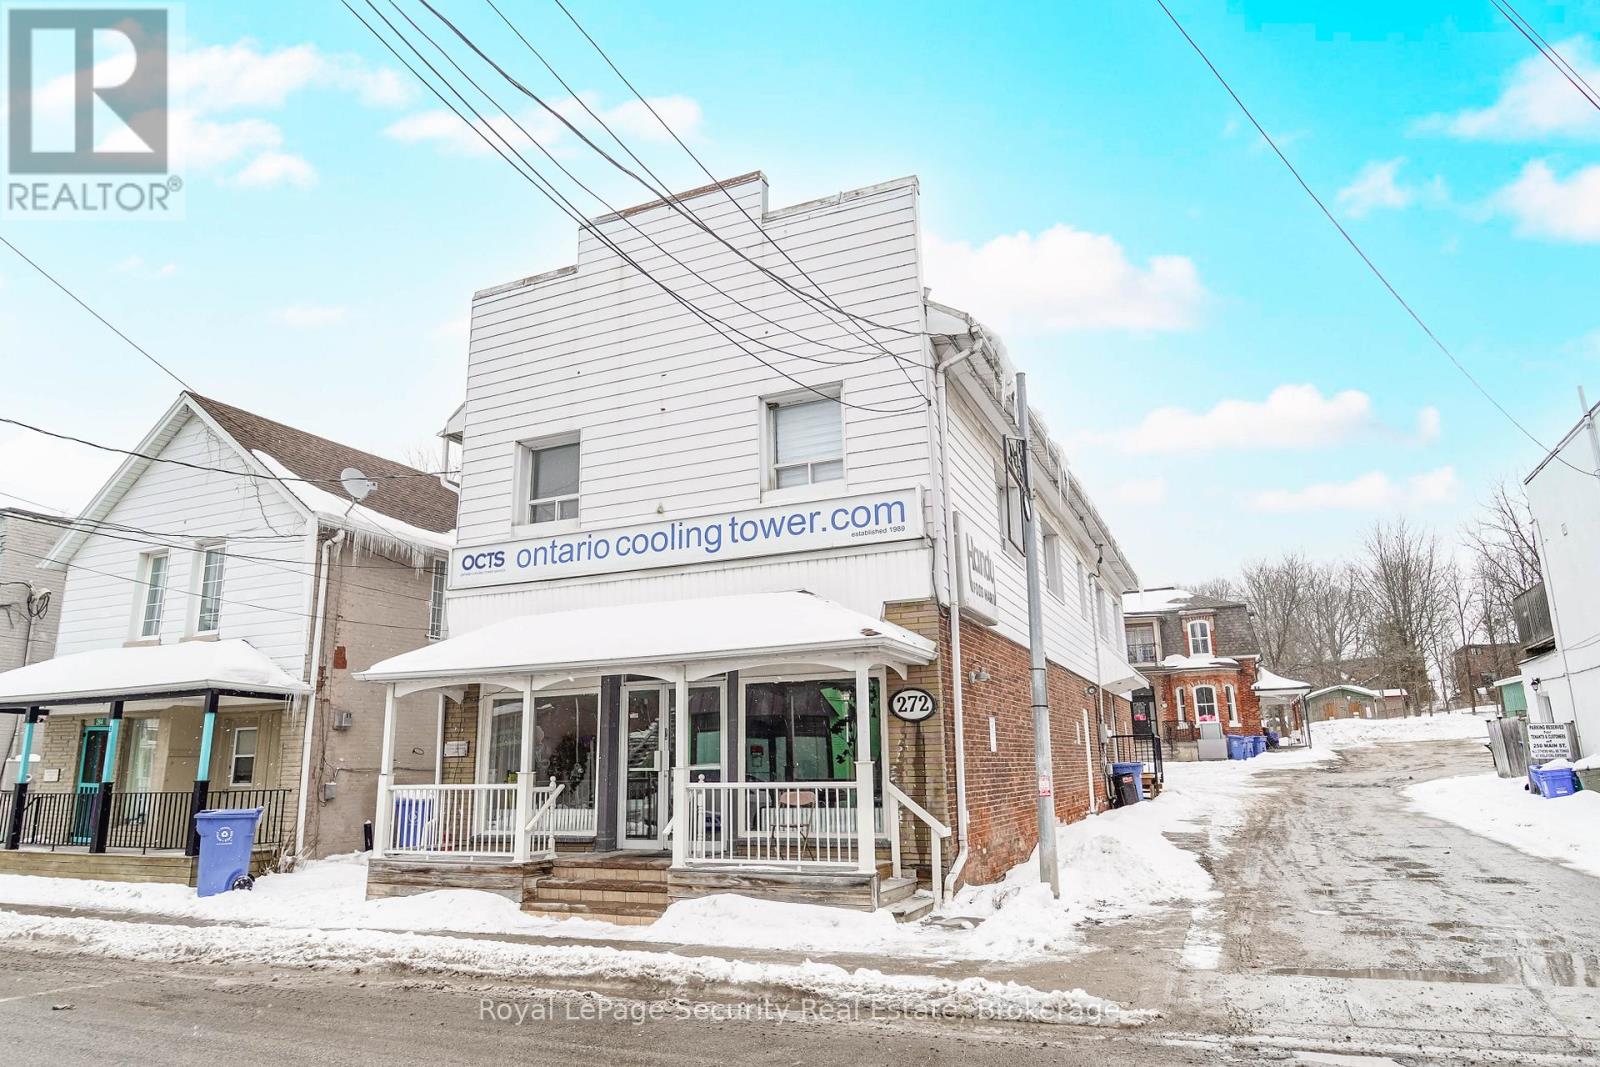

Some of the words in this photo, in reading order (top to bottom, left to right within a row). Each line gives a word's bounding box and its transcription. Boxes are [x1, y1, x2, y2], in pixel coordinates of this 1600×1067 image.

[851, 528, 887, 537] established
[890, 525, 905, 533] 1989
[462, 551, 505, 571] OCTS
[897, 695, 930, 713] 272
